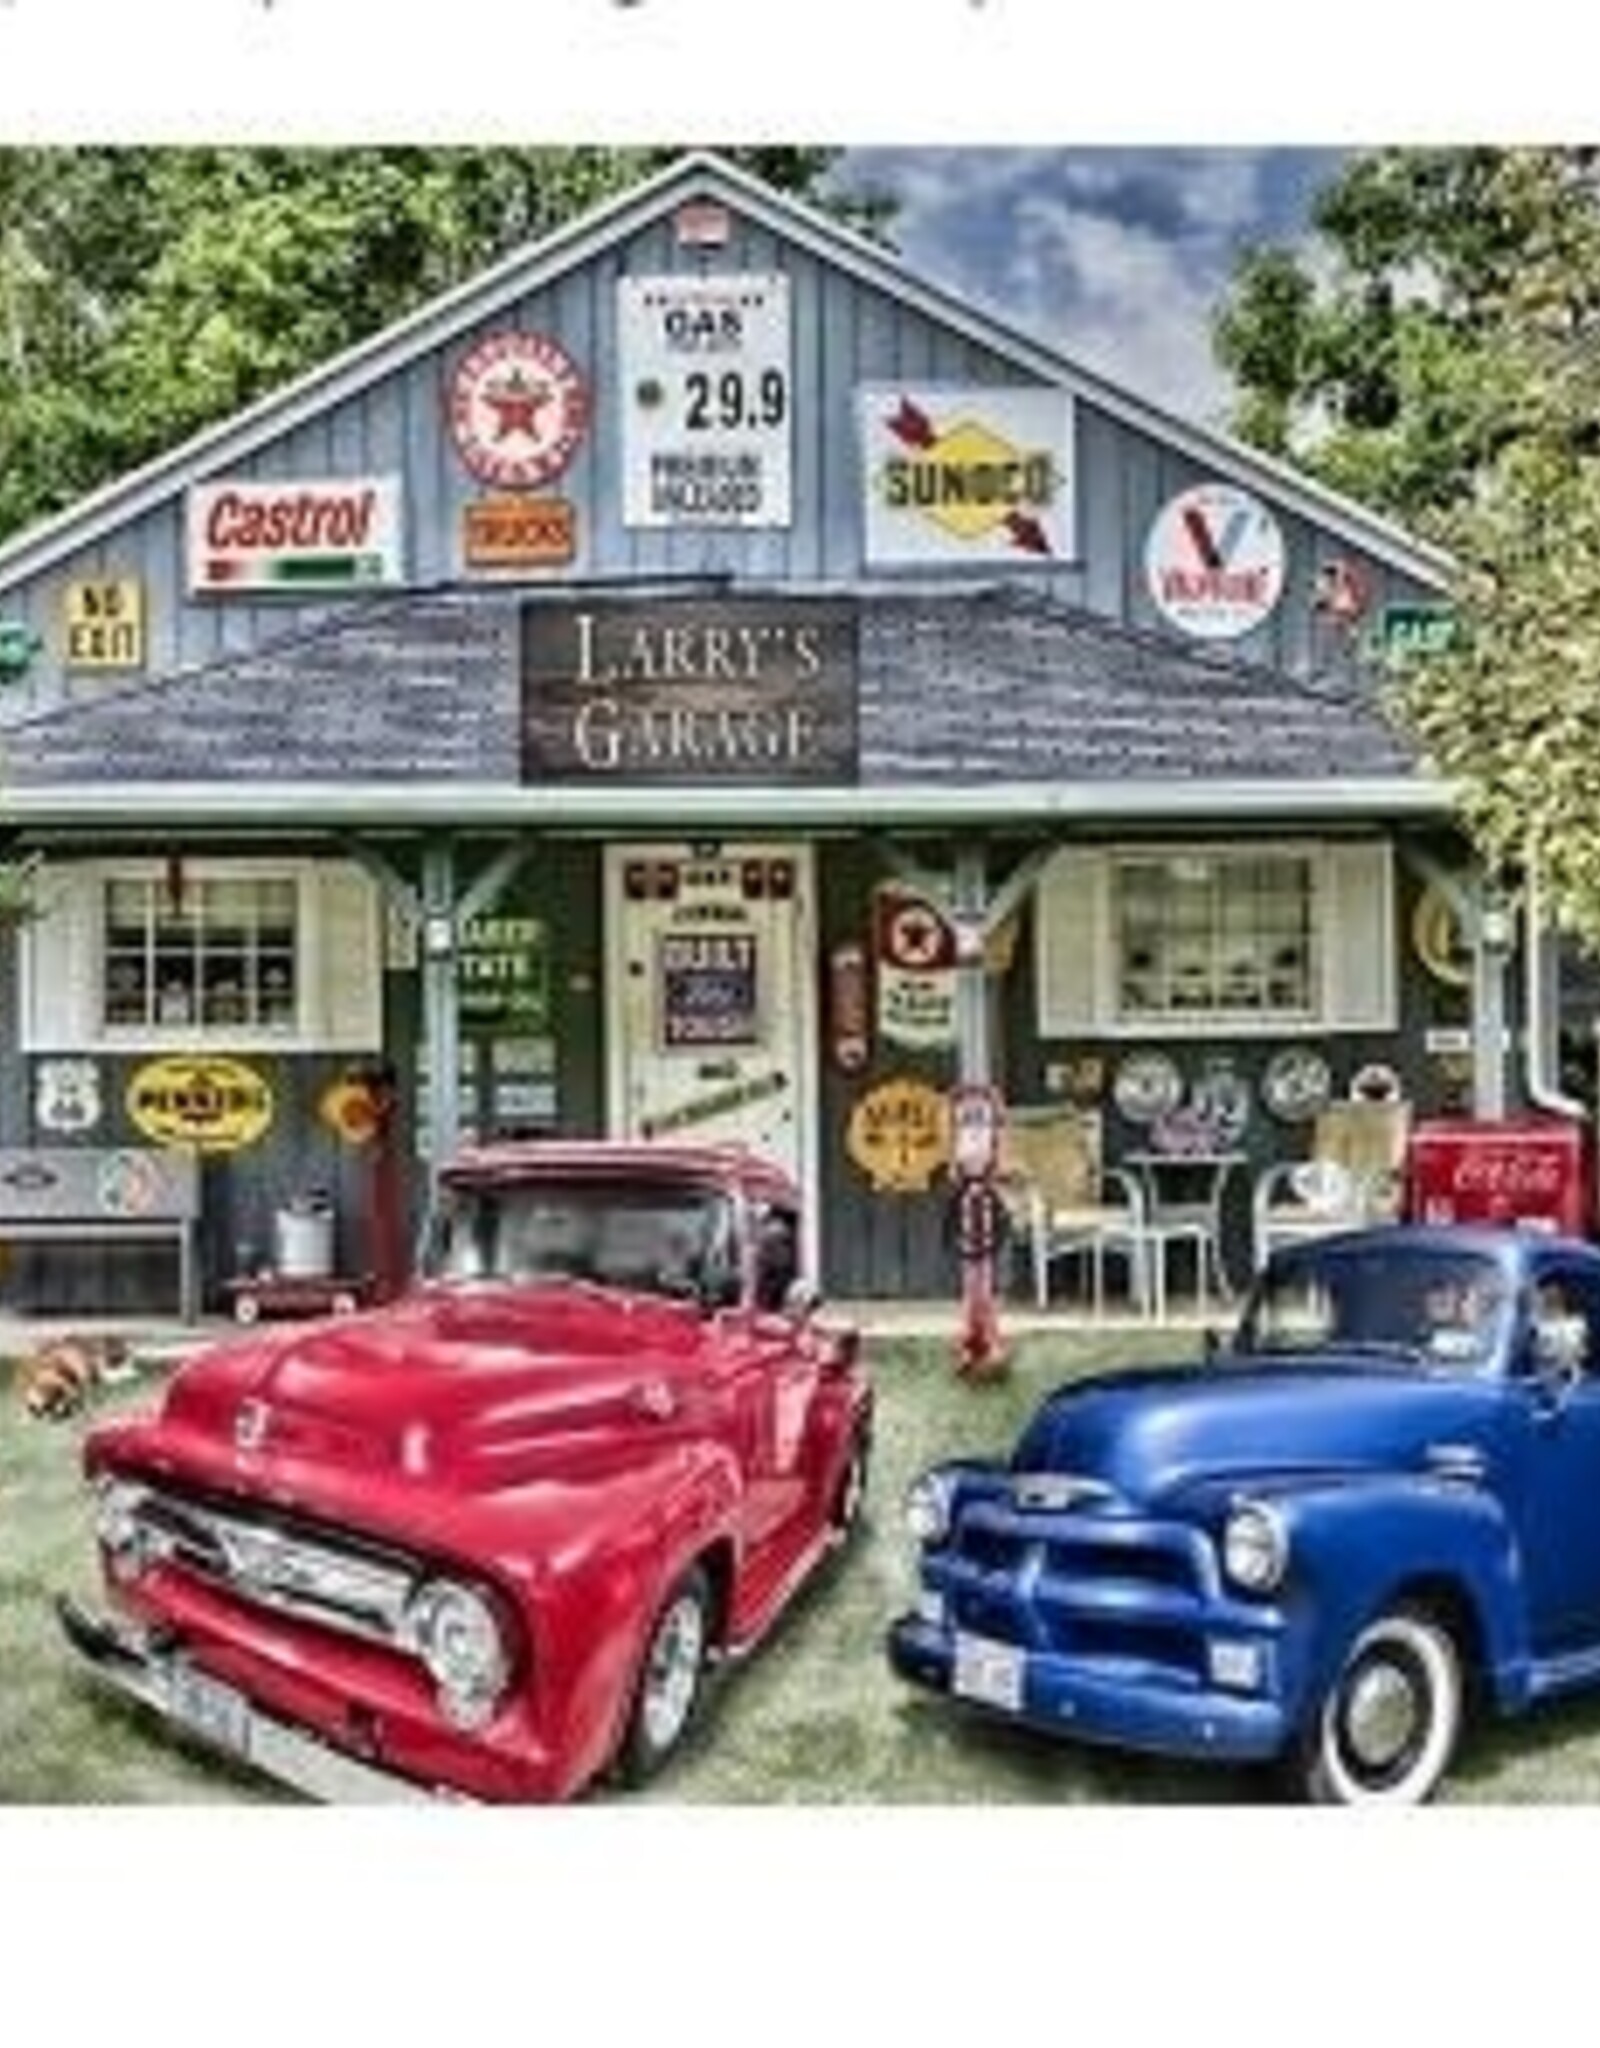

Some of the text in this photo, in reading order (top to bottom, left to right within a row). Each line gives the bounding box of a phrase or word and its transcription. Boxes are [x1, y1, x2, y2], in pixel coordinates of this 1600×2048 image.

[685, 371, 786, 430] 29.9
[886, 452, 1053, 507] SUNOCO
[206, 490, 375, 549] Castrol
[83, 586, 124, 617] NO
[69, 622, 134, 659] EXIT
[575, 615, 821, 684] LARRY'S
[574, 698, 821, 769] GARAGE
